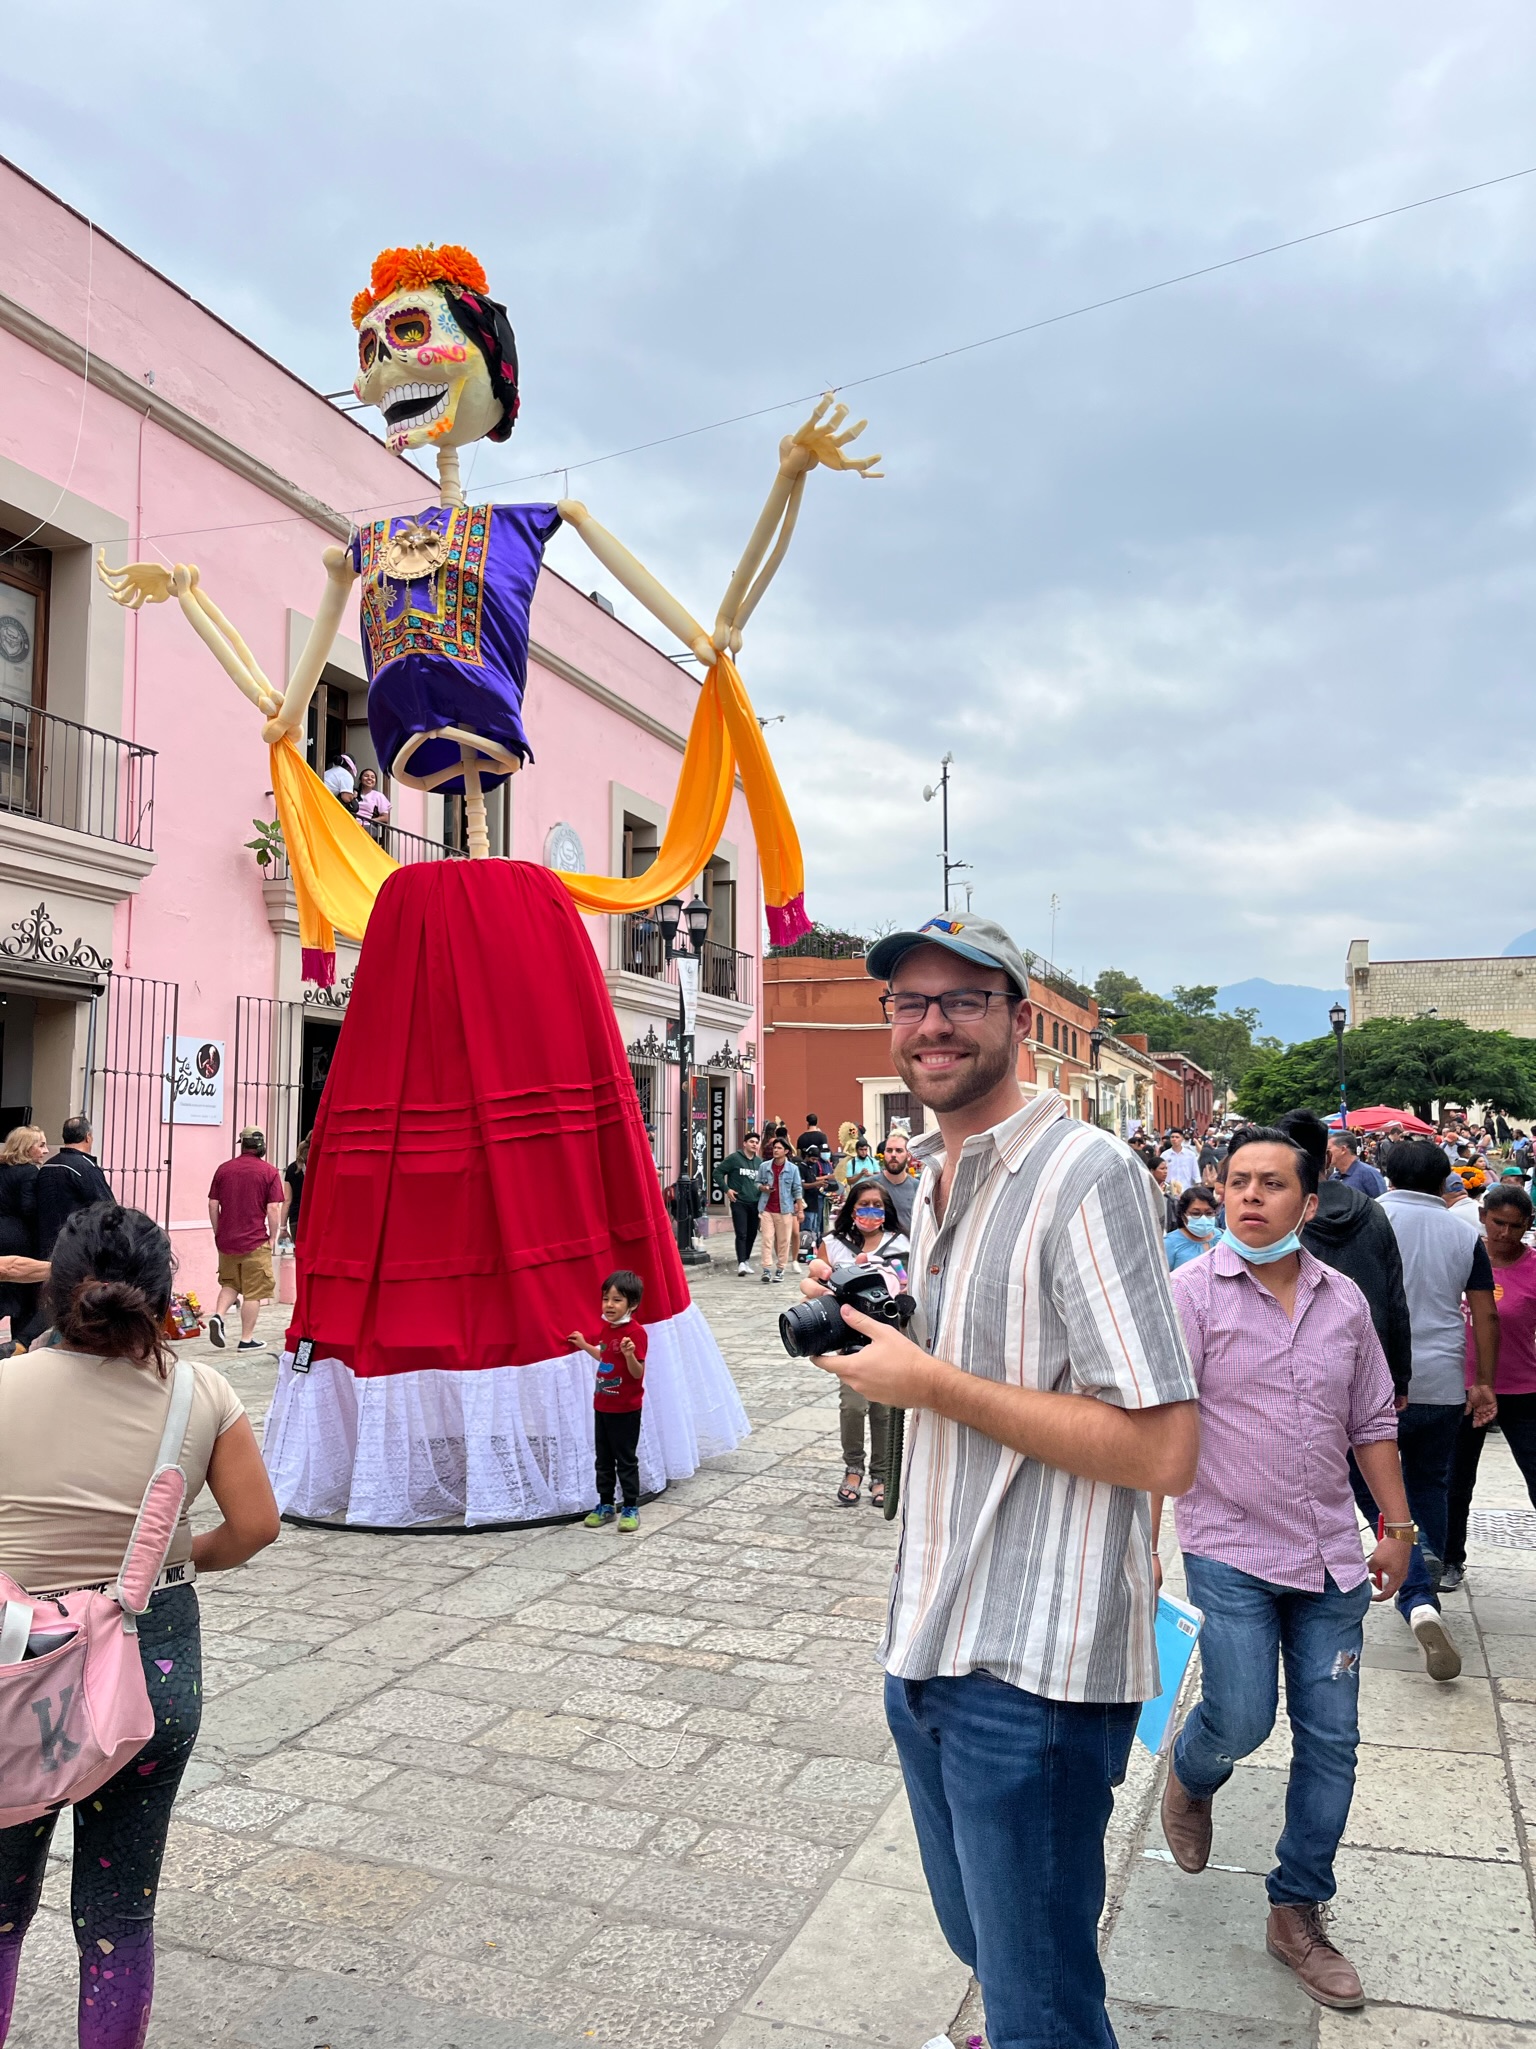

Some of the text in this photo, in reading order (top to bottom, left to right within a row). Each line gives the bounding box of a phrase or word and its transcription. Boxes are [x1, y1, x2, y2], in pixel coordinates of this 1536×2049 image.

[176, 1056, 192, 1076] La
[166, 1074, 216, 1102] Petra
[165, 1565, 185, 1584] NIKE
[31, 1684, 82, 1773] K
